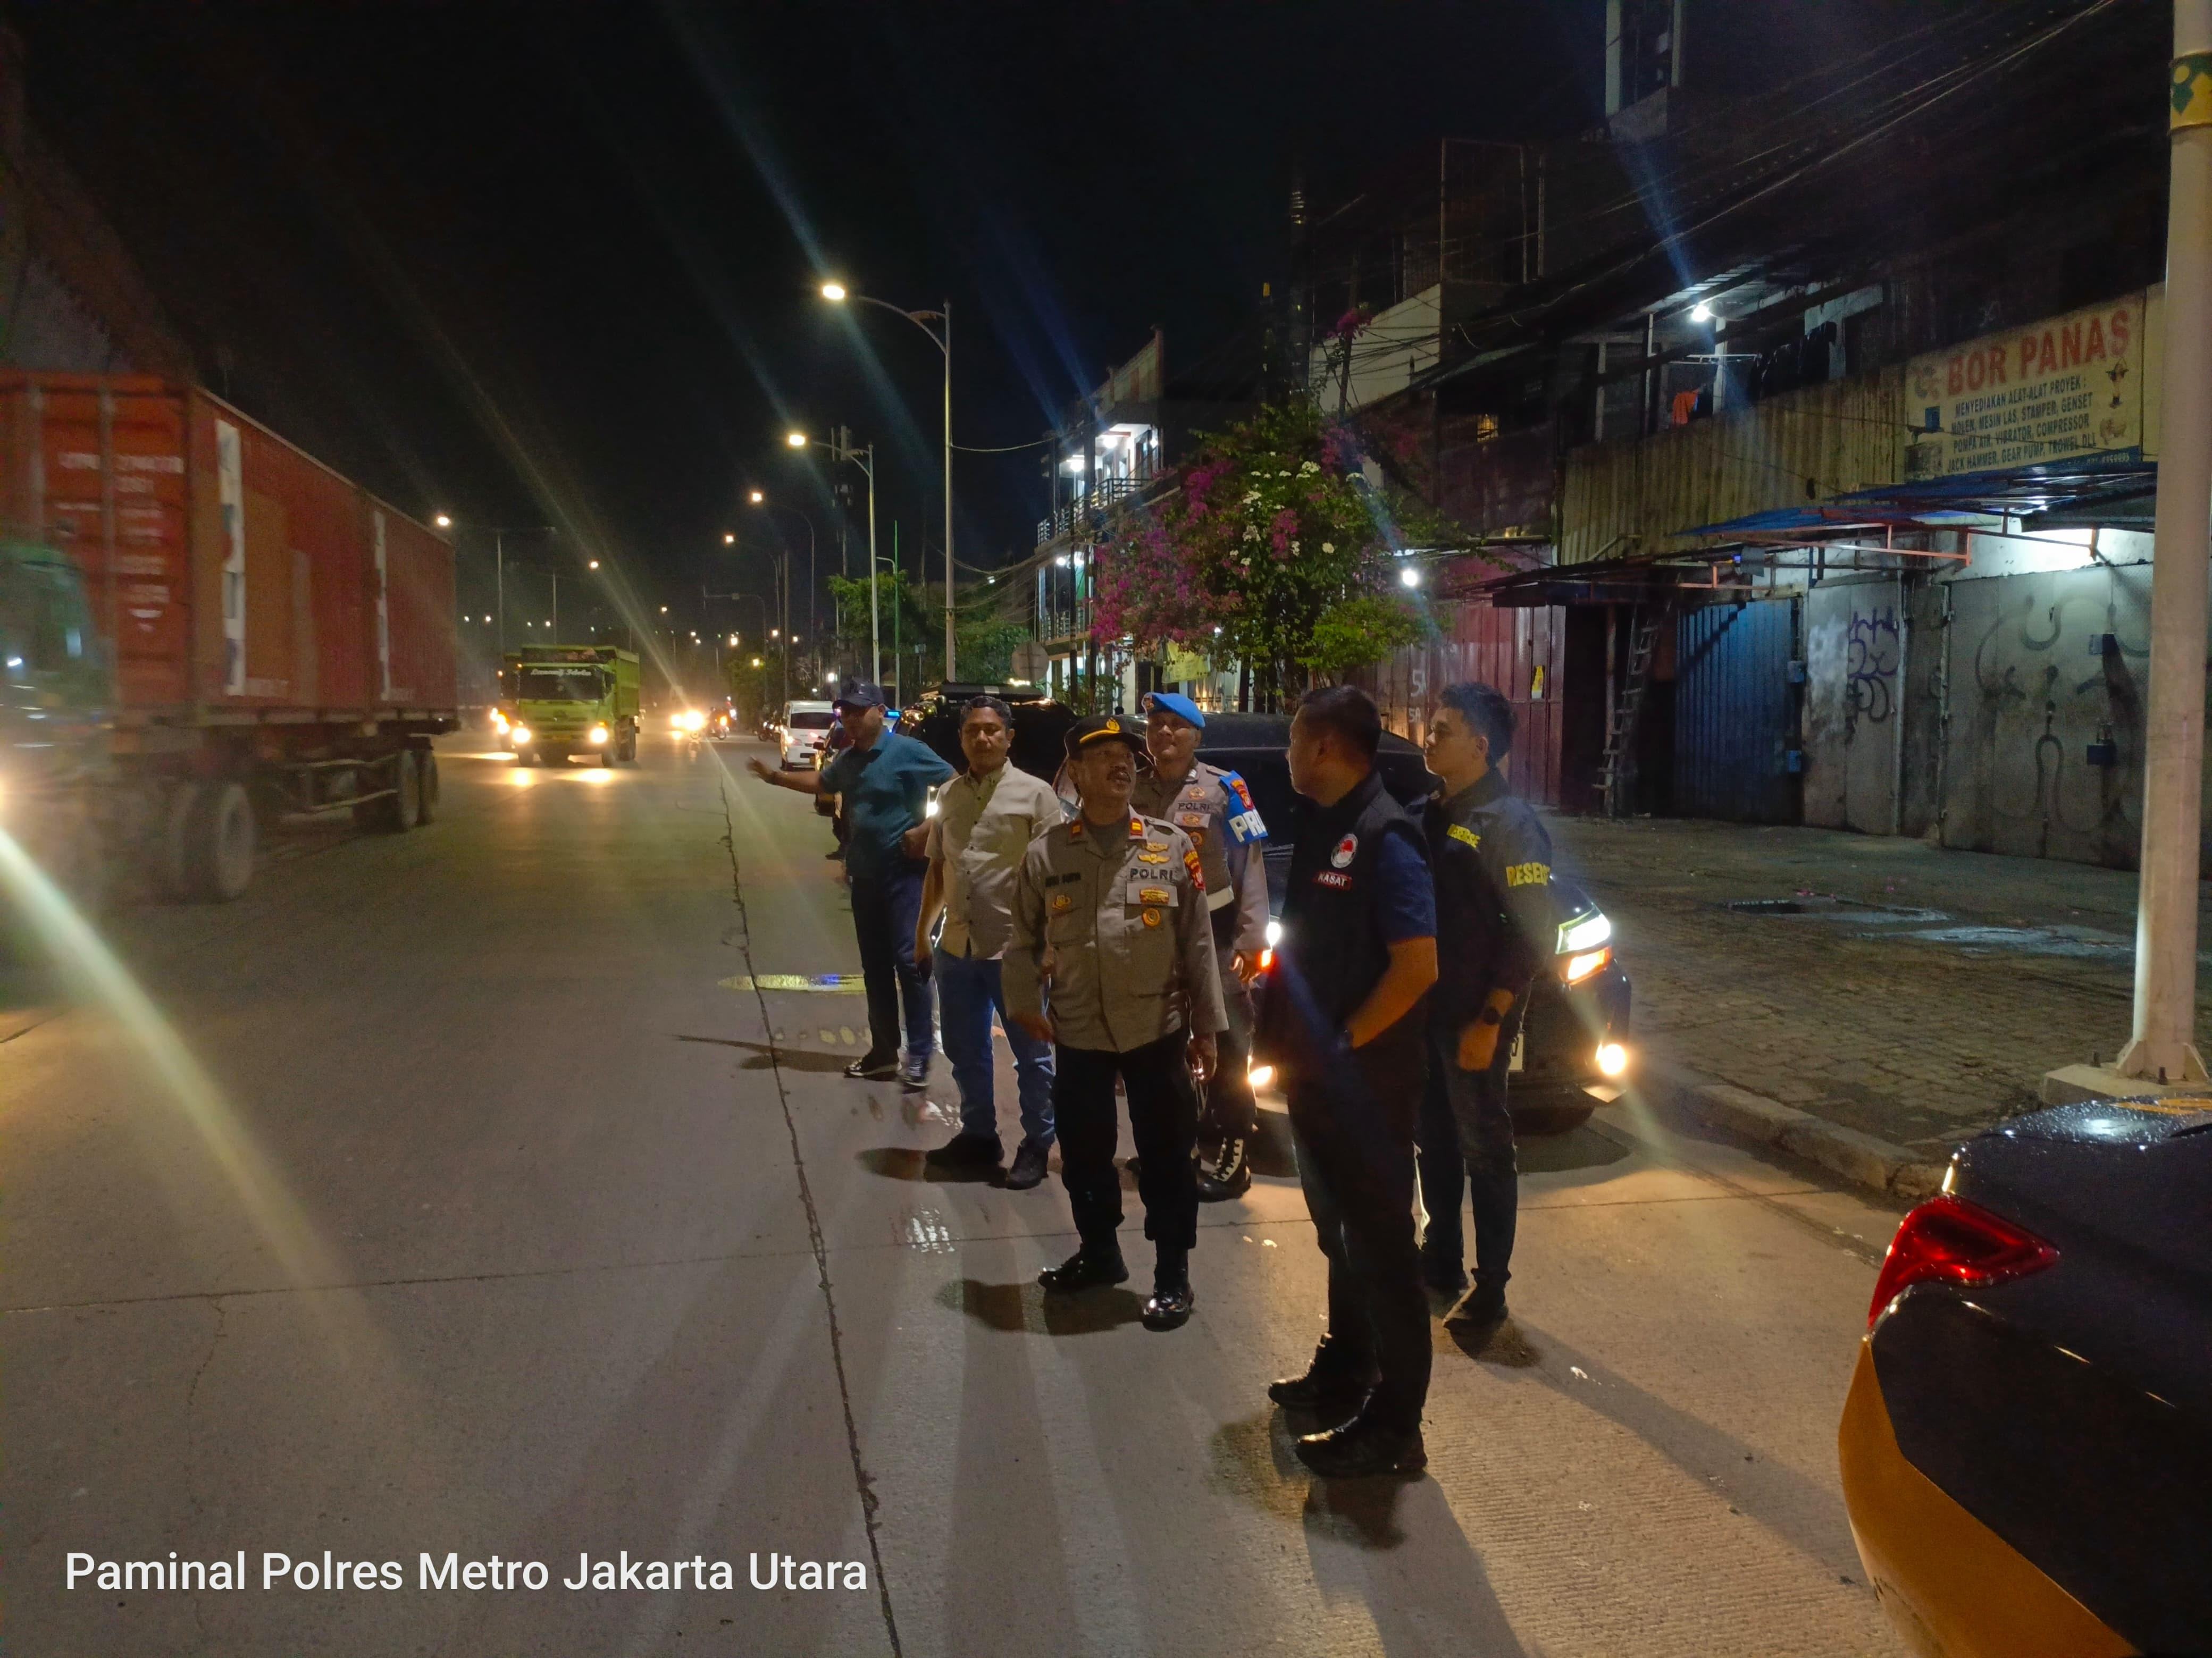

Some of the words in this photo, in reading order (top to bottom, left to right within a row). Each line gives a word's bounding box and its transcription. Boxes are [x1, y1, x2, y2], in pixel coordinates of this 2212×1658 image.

[1946, 346, 2007, 397] BOR
[2021, 309, 2130, 381] PANAS
[1955, 393, 2006, 418] MENYEDIAKAN
[2008, 382, 2047, 405] ALAT-ALAT
[2050, 375, 2081, 395] PROYEK
[1979, 413, 2001, 430] MESIN
[2062, 391, 2093, 413] GENSET
[2037, 413, 2090, 438] COMPRESSOR
[1947, 458, 1965, 473] JACK
[2001, 445, 2021, 463] GEAR
[1178, 802, 1211, 811] POLRI
[1130, 868, 1173, 880] POLRI
[1318, 872, 1347, 887] KASAT
